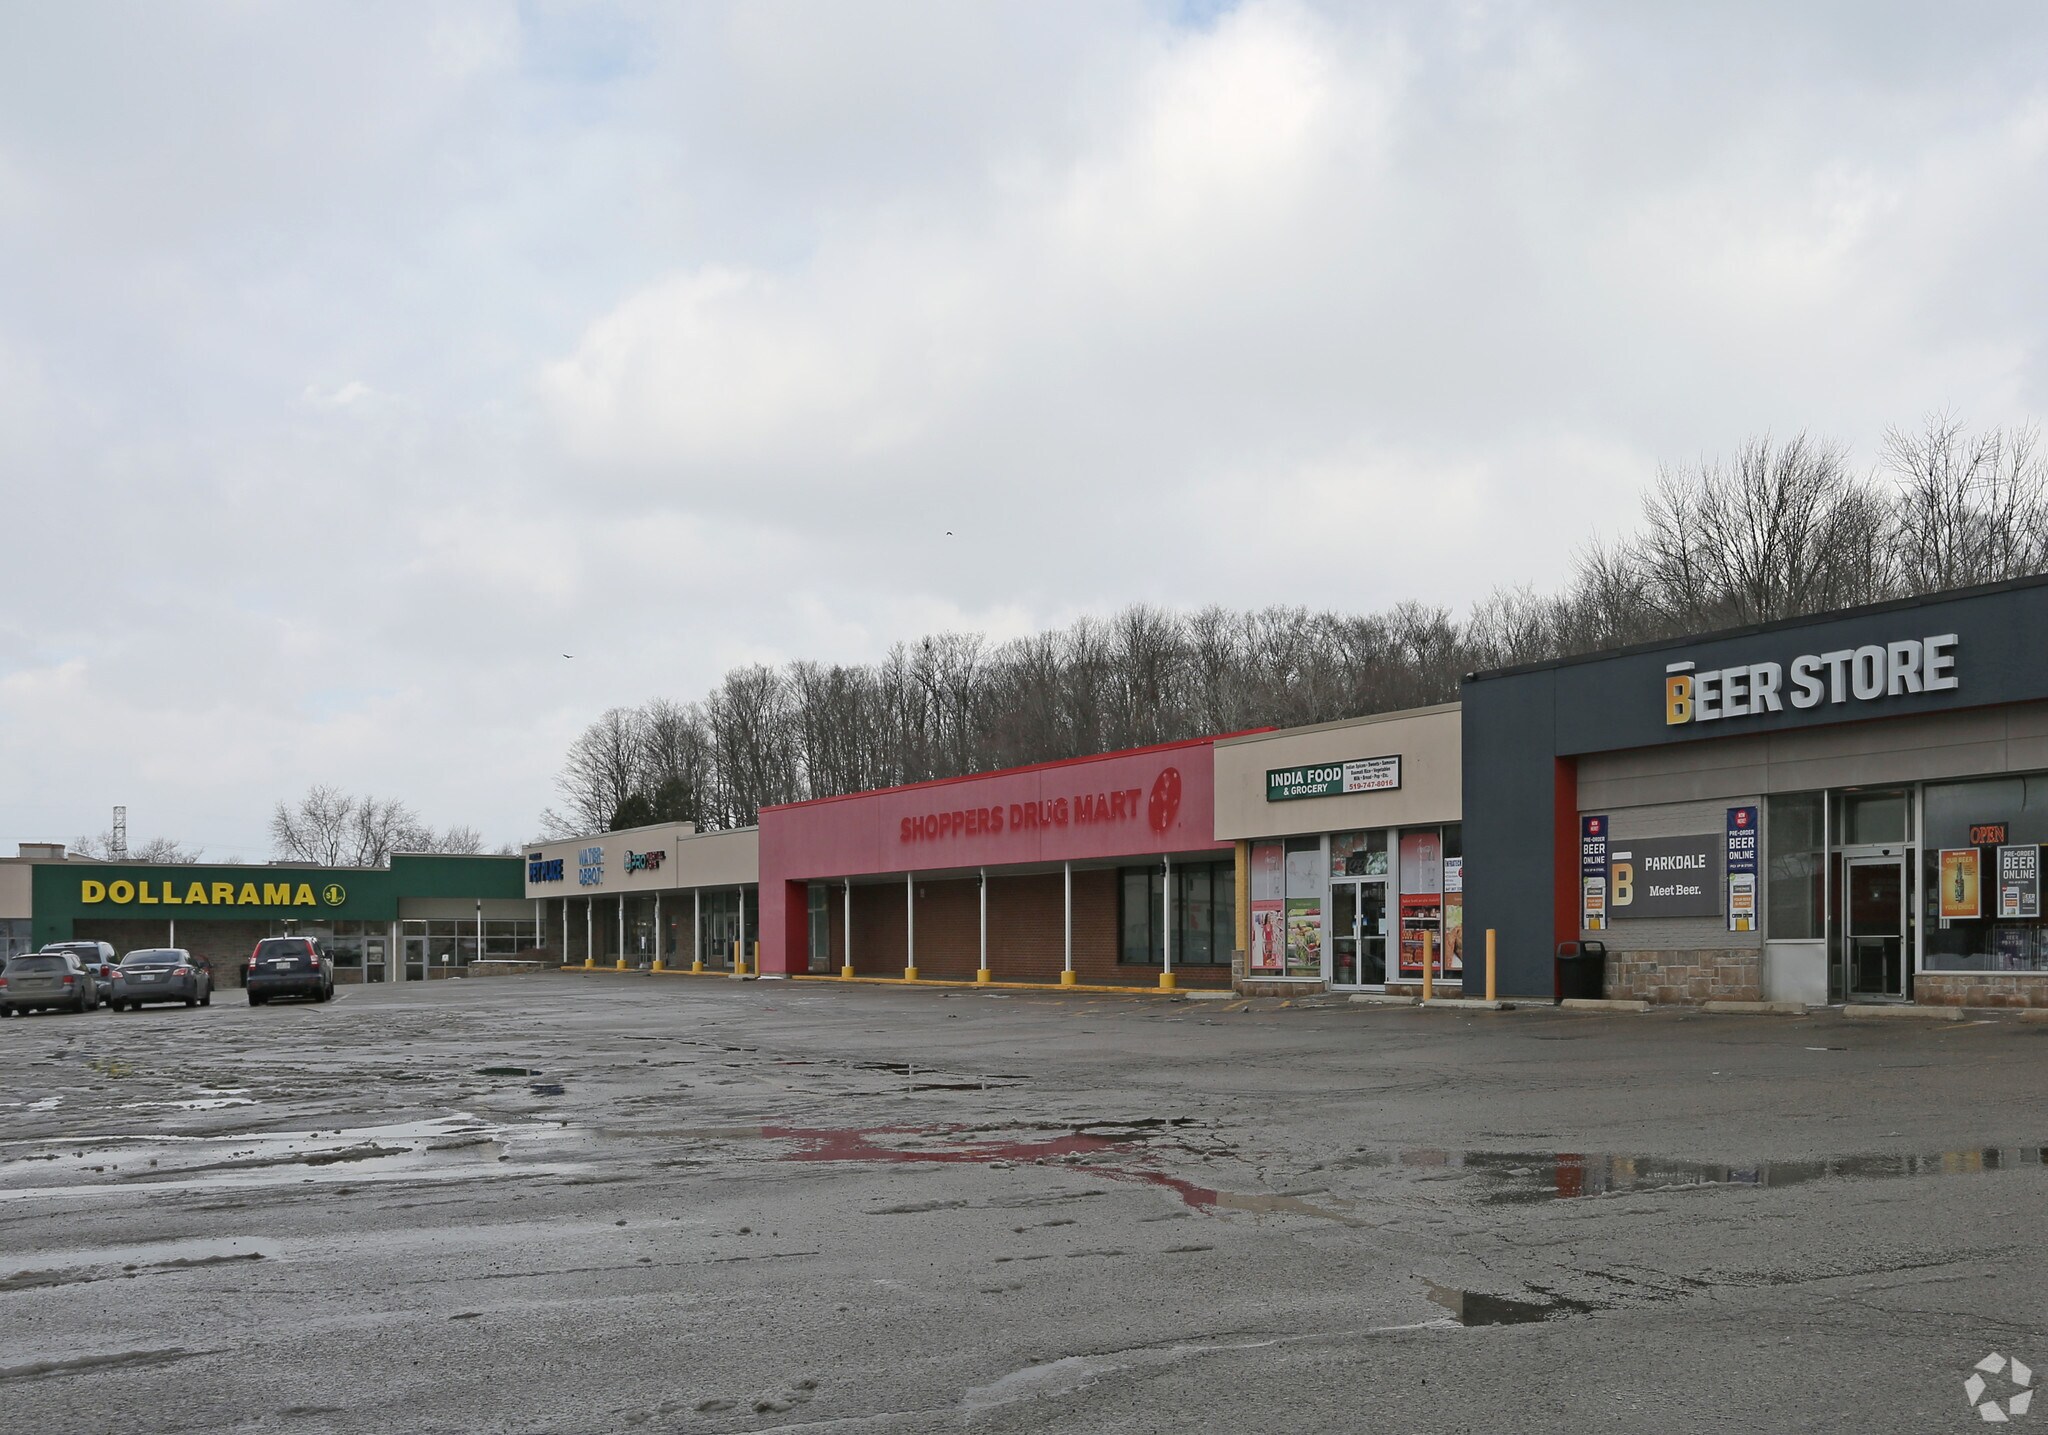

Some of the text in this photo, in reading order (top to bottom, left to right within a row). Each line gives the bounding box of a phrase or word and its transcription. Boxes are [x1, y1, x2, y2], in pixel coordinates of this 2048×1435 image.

[1665, 633, 1959, 725] BEER STORE
[1271, 767, 1342, 787] INDIA FOOD
[1283, 783, 1328, 796] & GROCERY
[1349, 780, 1394, 790] 519-747-8016
[900, 788, 1143, 843] SHOPPERS DRUG MART
[1970, 826, 2005, 844] OPEN
[1583, 843, 1605, 854] BEER
[1729, 837, 1754, 849] BEER
[1583, 856, 1605, 864] ONLINE
[1729, 850, 1754, 860] ONLINE
[632, 854, 646, 870] PRO
[1645, 854, 1706, 871] PARKDALE
[2003, 857, 2035, 869] BEER
[579, 867, 604, 885] DEPOT
[2003, 870, 2035, 879] ONLINE
[81, 880, 317, 905] DOLLARAMA
[1649, 884, 1701, 897] Meet Beer.
